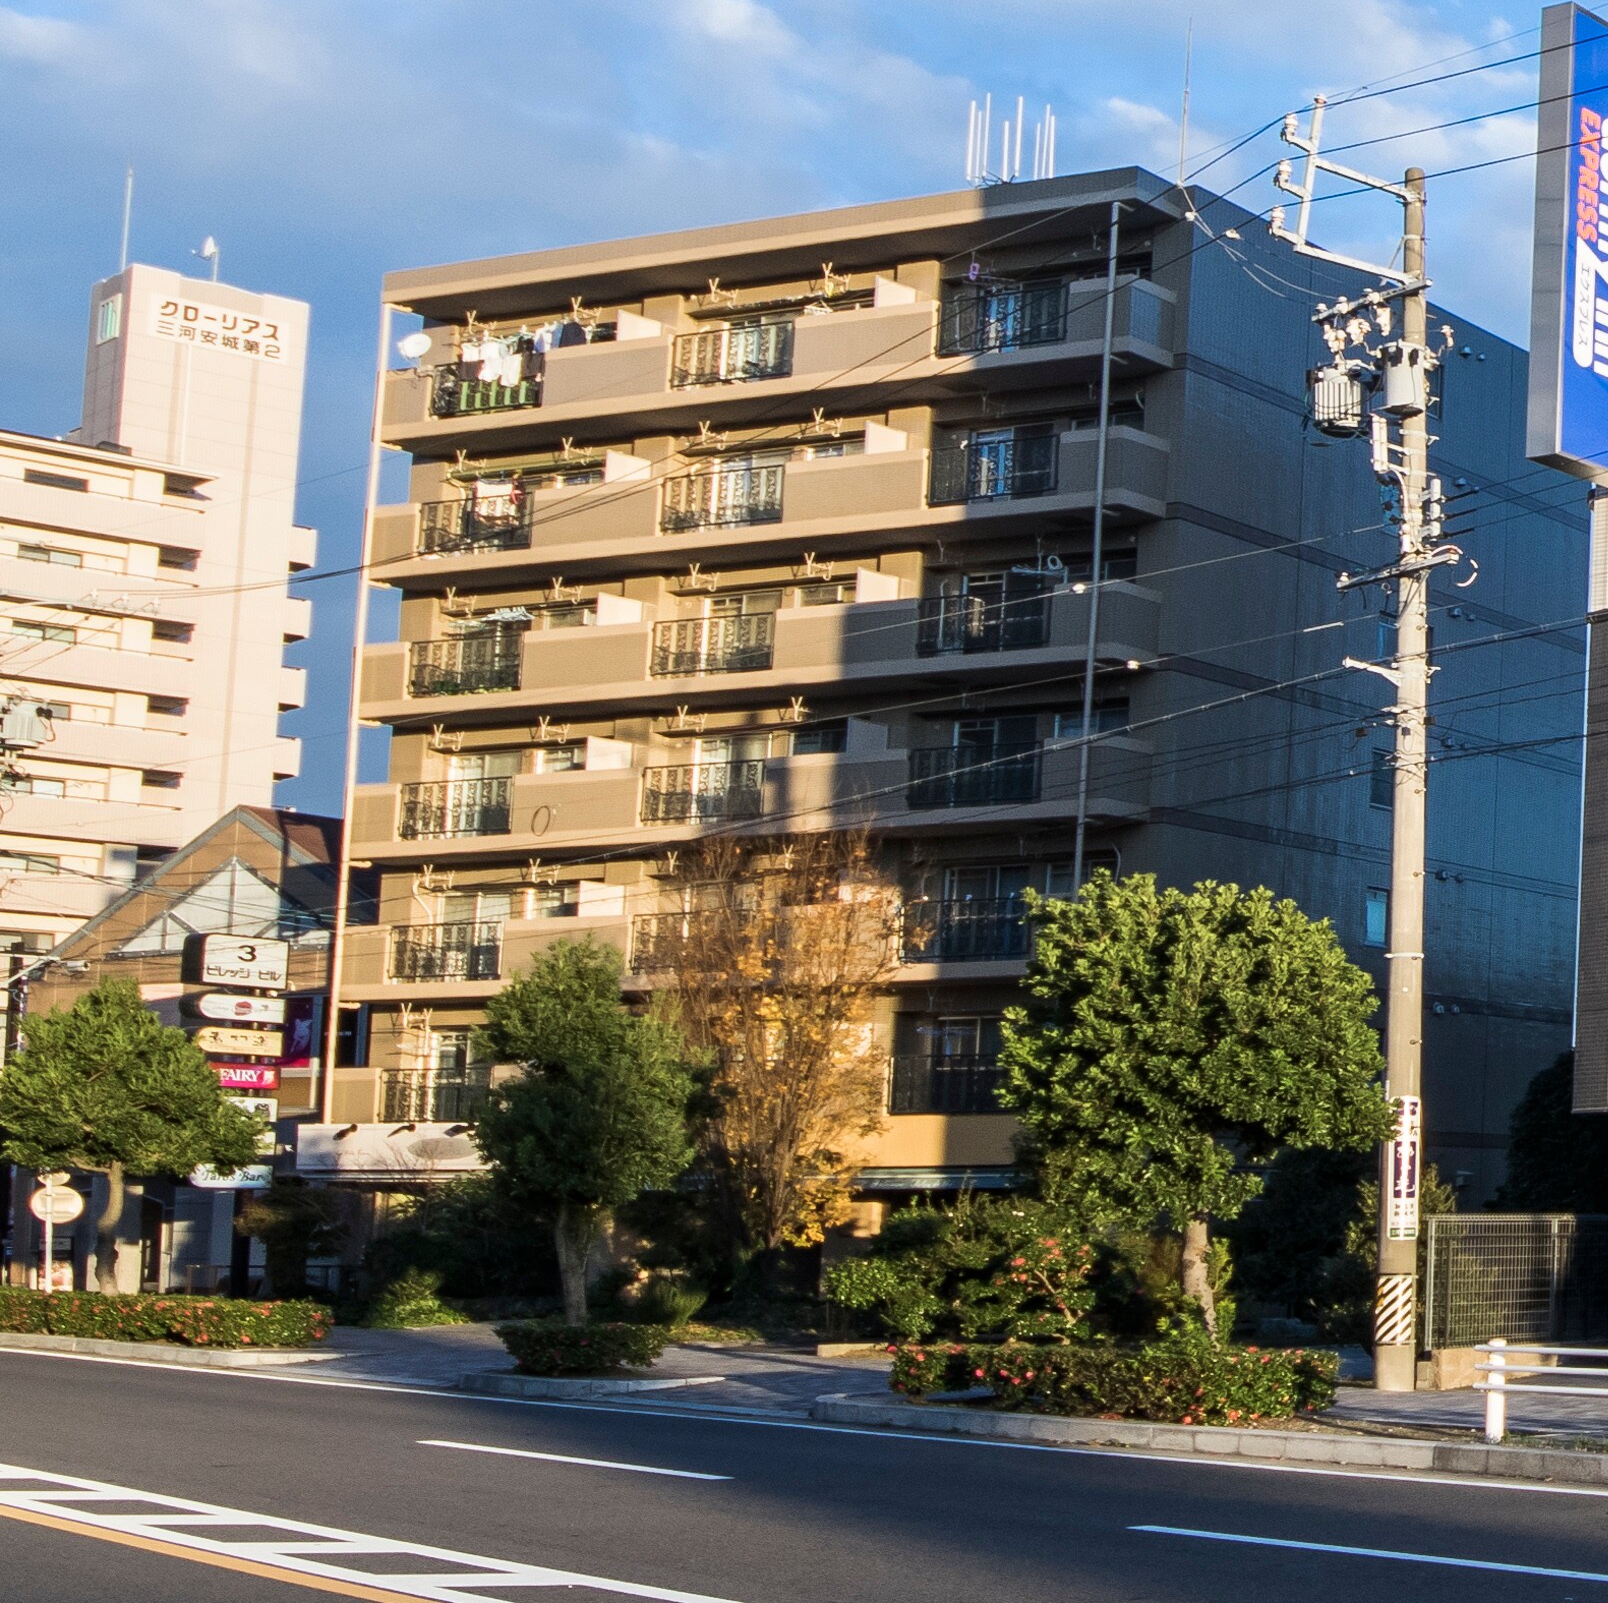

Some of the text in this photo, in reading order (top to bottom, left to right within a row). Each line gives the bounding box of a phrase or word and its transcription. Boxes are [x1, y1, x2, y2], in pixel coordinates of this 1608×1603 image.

[1576, 107, 1601, 244] EXPRESS
[156, 320, 281, 359] 三河安城第2
[160, 300, 279, 341] クローリアス
[237, 944, 257, 962] 3
[219, 1067, 261, 1083] FAIRY
